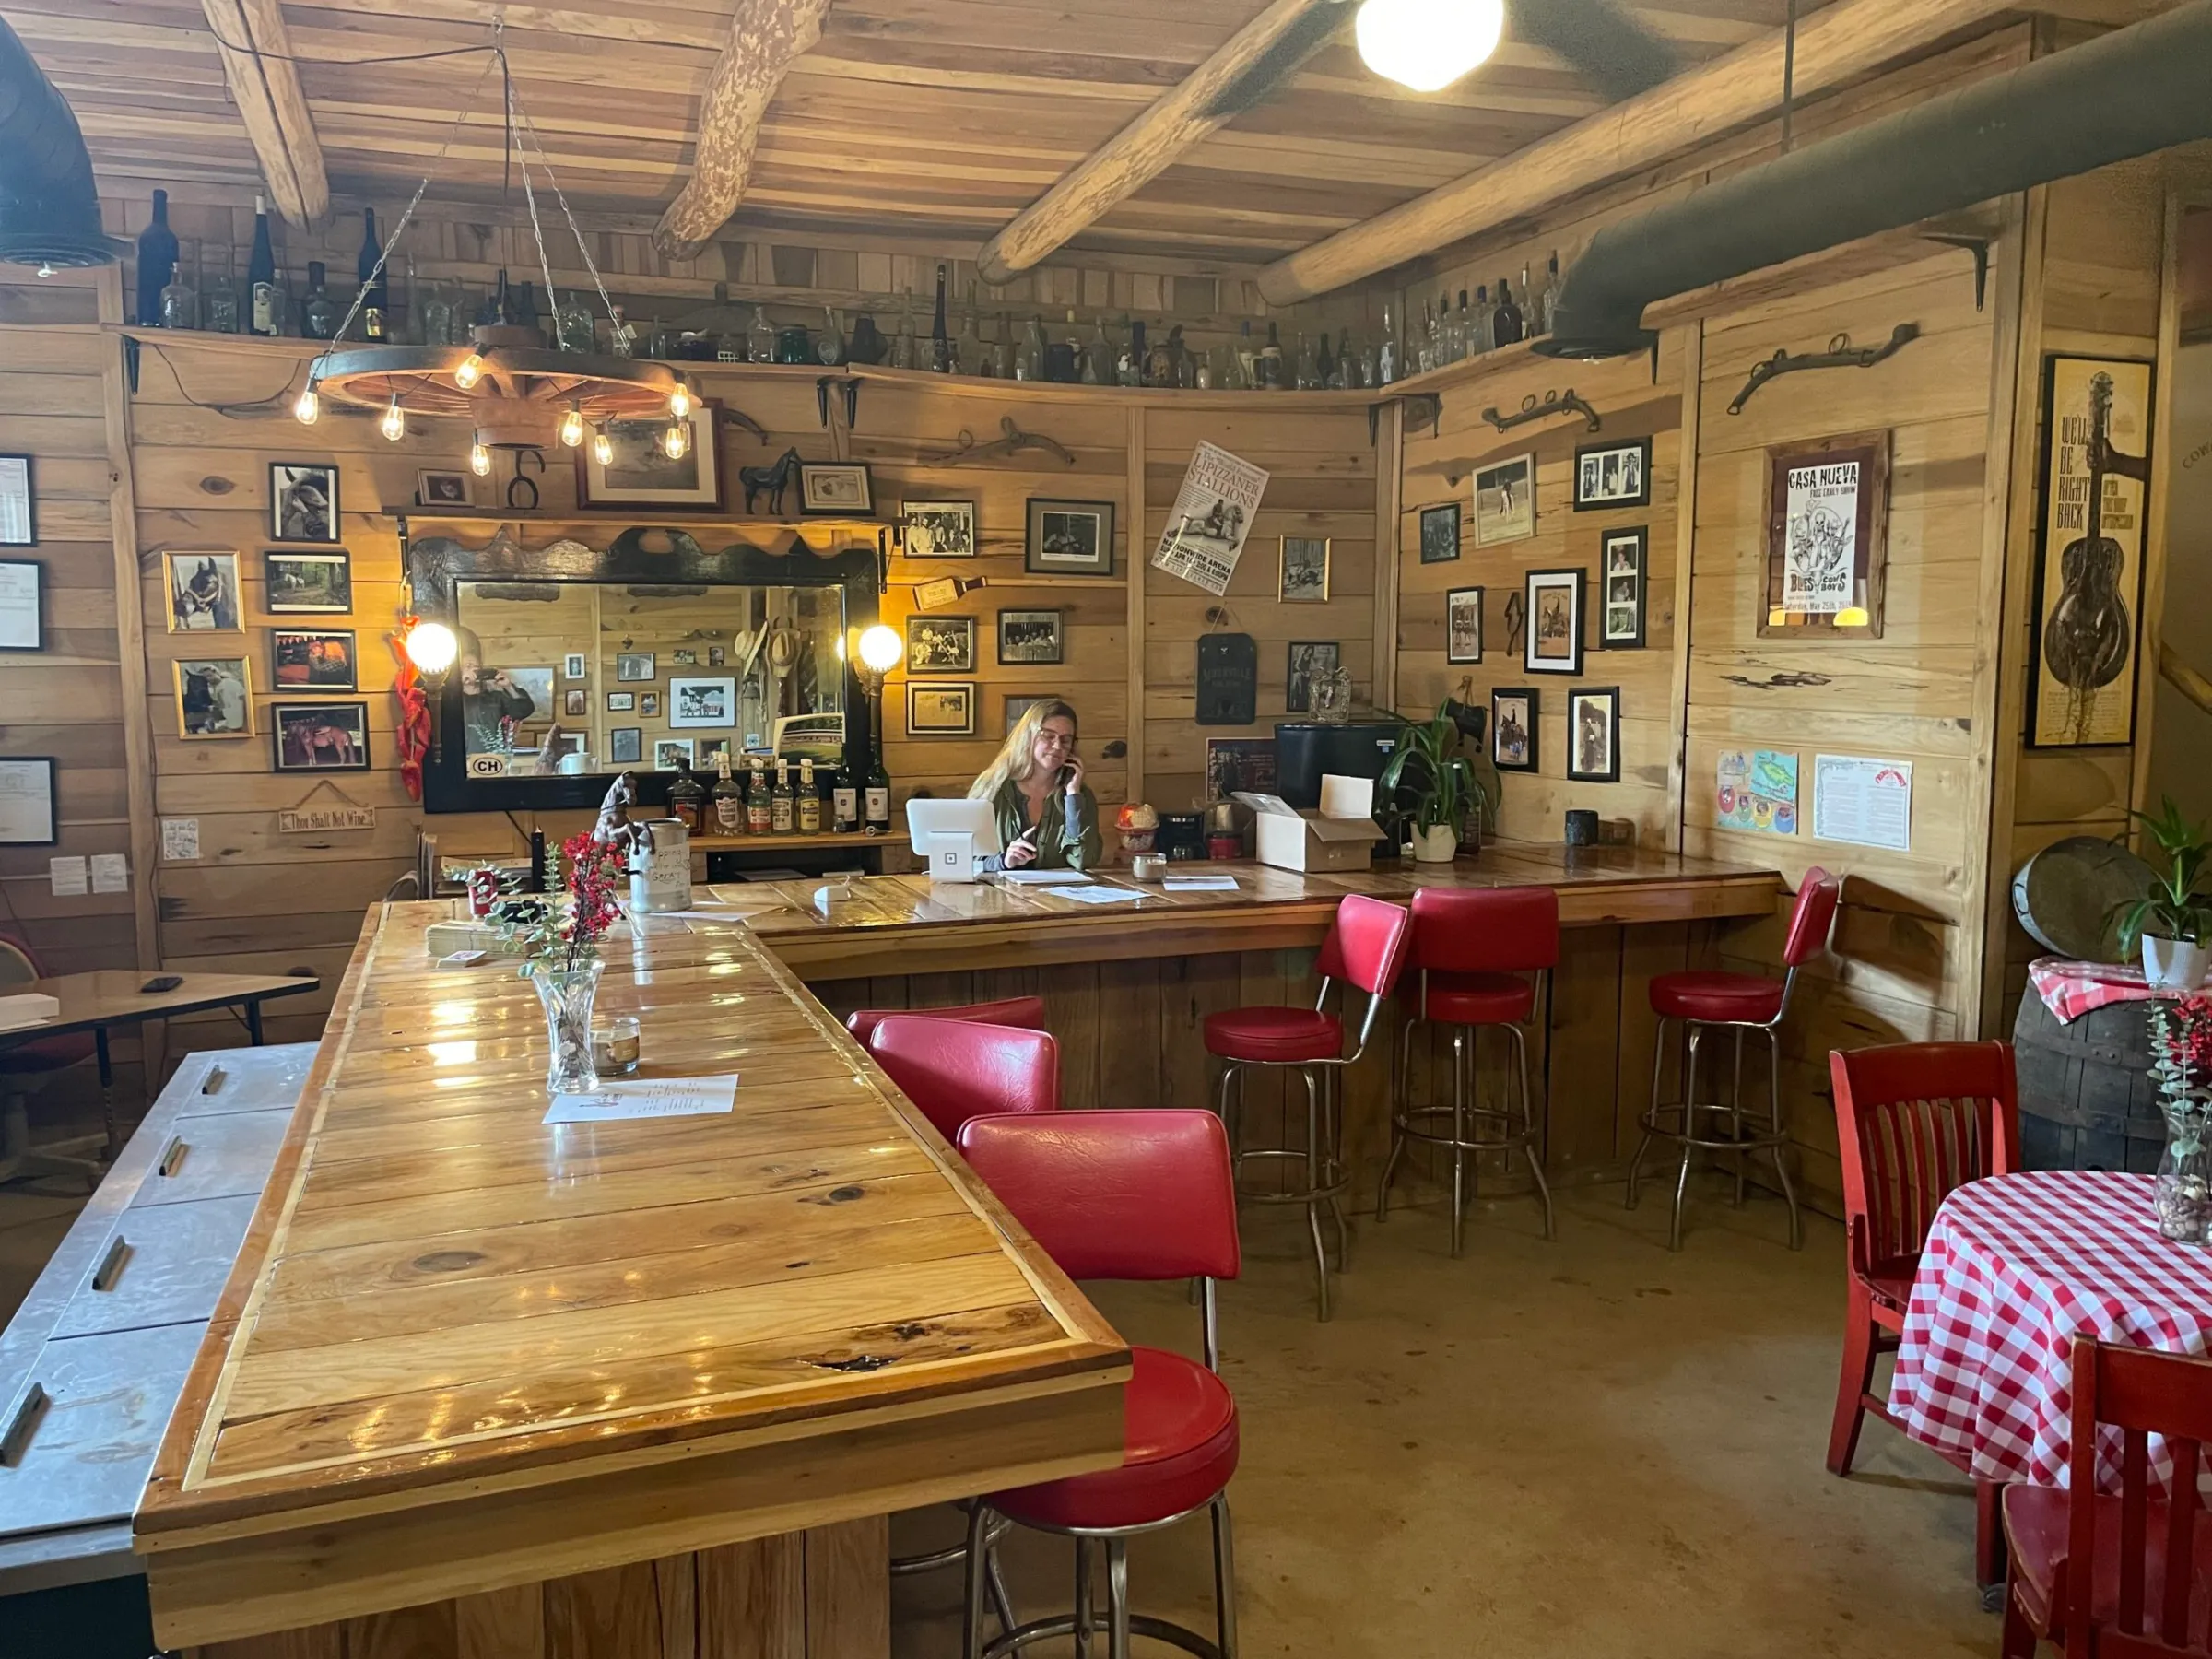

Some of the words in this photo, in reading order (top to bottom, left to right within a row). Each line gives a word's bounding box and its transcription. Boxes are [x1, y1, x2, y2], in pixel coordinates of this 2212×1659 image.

[2062, 415, 2088, 445] WE'LL
[2060, 446, 2073, 475] BE
[1188, 466, 1256, 510] STALLIONS
[1194, 453, 1259, 497] LIPIZZANER
[1789, 469, 1816, 490] CASA
[1820, 465, 1857, 486] NUEVA
[2058, 477, 2090, 501] RIGHT
[2057, 503, 2084, 531] BACK
[1208, 559, 1230, 574] ARENA
[477, 761, 499, 771] CH
[292, 814, 309, 830] Thou
[311, 811, 330, 828] Shall
[332, 810, 346, 827] Not
[347, 810, 366, 826] Wine
